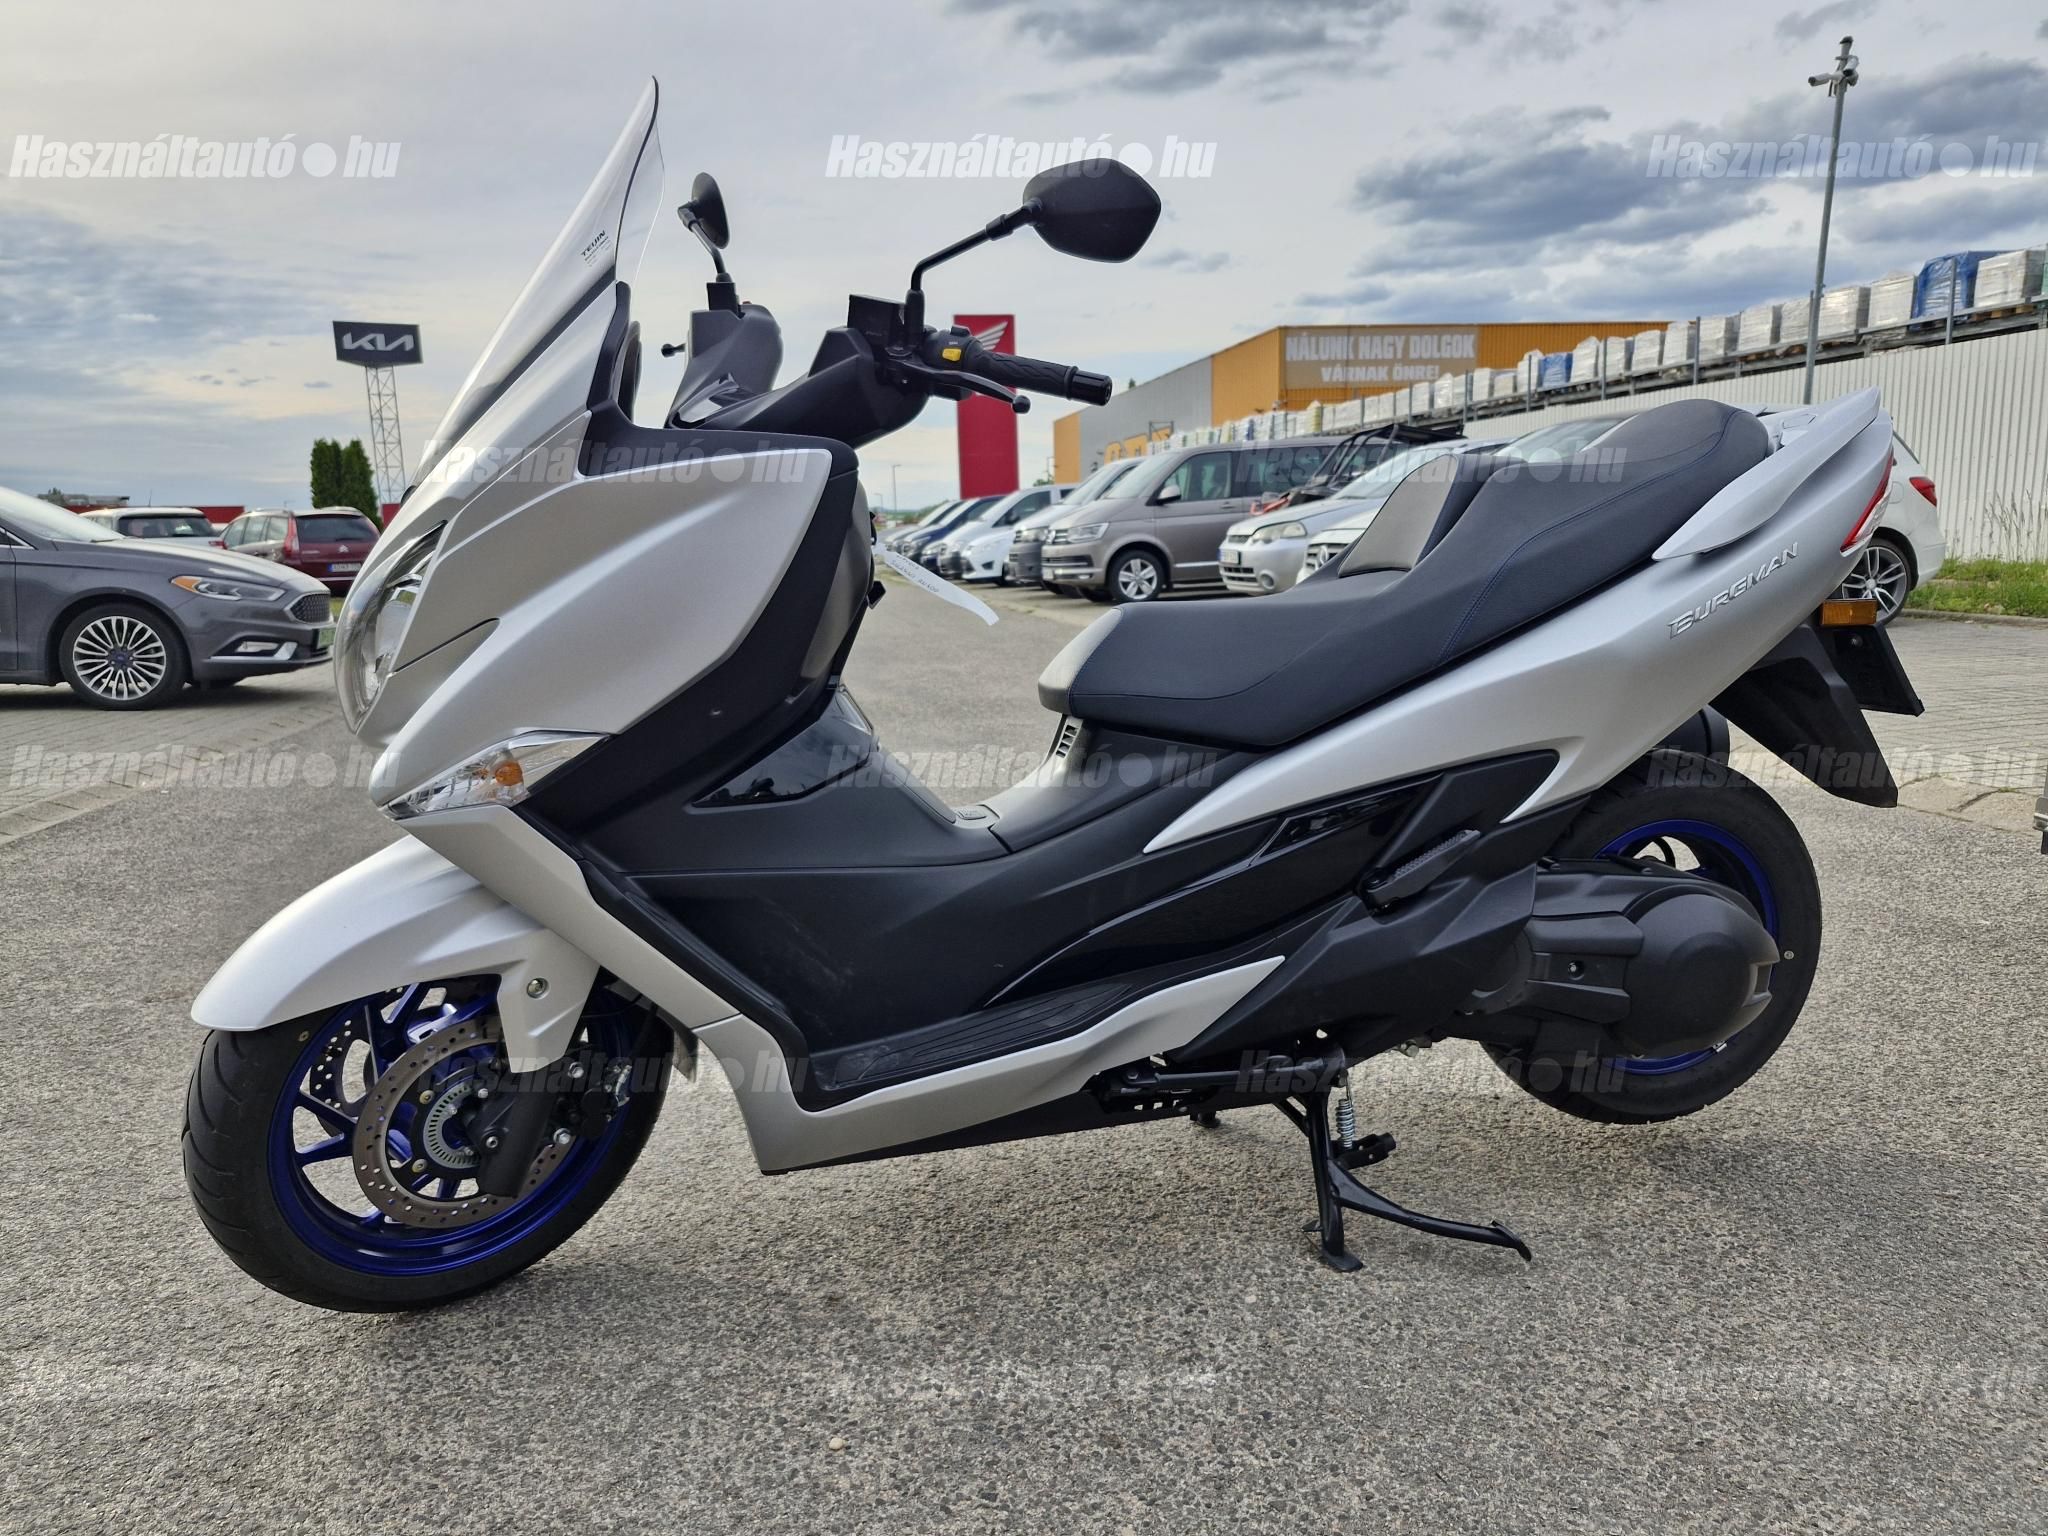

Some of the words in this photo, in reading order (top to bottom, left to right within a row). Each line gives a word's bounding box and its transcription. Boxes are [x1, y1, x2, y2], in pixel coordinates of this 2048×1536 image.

[342, 331, 414, 352] KIA
[1285, 331, 1354, 361] NÁLUNK
[1359, 335, 1406, 360] NAGY
[1409, 334, 1475, 359] DOLGOK
[1321, 363, 1389, 382] VÁRNAK
[1667, 541, 1799, 640] BURGMAN
